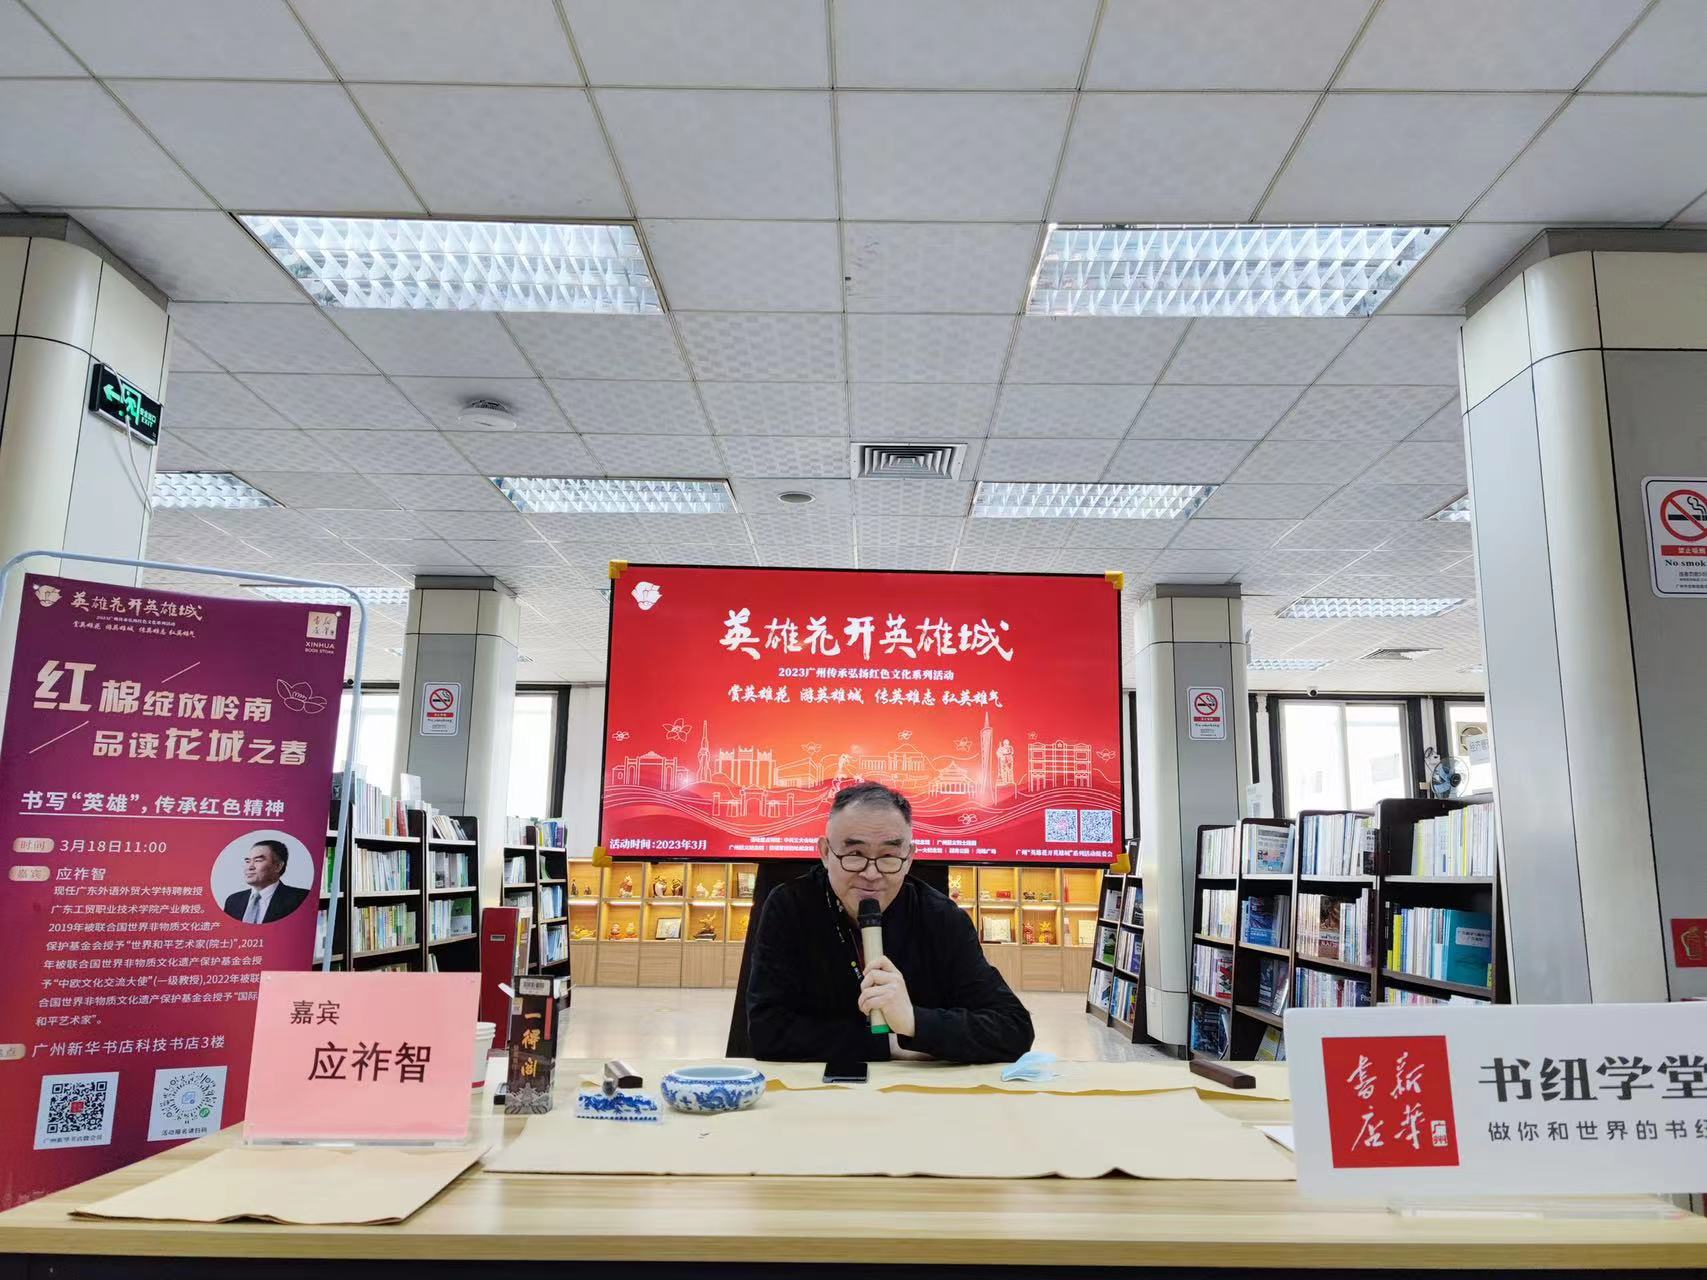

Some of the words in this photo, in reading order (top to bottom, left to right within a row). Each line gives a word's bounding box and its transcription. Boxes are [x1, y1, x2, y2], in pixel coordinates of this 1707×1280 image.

[1664, 559, 1679, 567] No
[70, 590, 203, 621] 英雄花开英雄城
[719, 607, 1014, 662] 英雄花开英雄城
[305, 641, 335, 650] XINHUA
[778, 666, 955, 681] 2023广州传承弘扬红色文化系列活动
[33, 660, 273, 723] 红棉绽放岭南
[727, 683, 791, 704] 赏英雄花
[799, 687, 865, 706] 游英雄城
[874, 688, 937, 706] 传英雄志
[92, 727, 308, 766] 品读花城之春
[20, 839, 47, 852] 时间
[59, 838, 168, 854] 3月18日11:00
[56, 866, 107, 881] 应祚智
[53, 886, 204, 897] 现任广东外语外贸大学特聘教授
[50, 903, 207, 915] 广东工贸职业技术学院产业教授。
[48, 922, 221, 933] 2019年被联合国世界非物质文化遗产
[43, 955, 263, 970] 年被联合国世界非物质文化遗产保护基金会授
[290, 1000, 341, 1025] 嘉宾
[31, 1034, 225, 1058] 广州新华书店科技书店3楼
[308, 1041, 432, 1083] 应祚智
[1478, 1055, 1707, 1103] 书纽学堂
